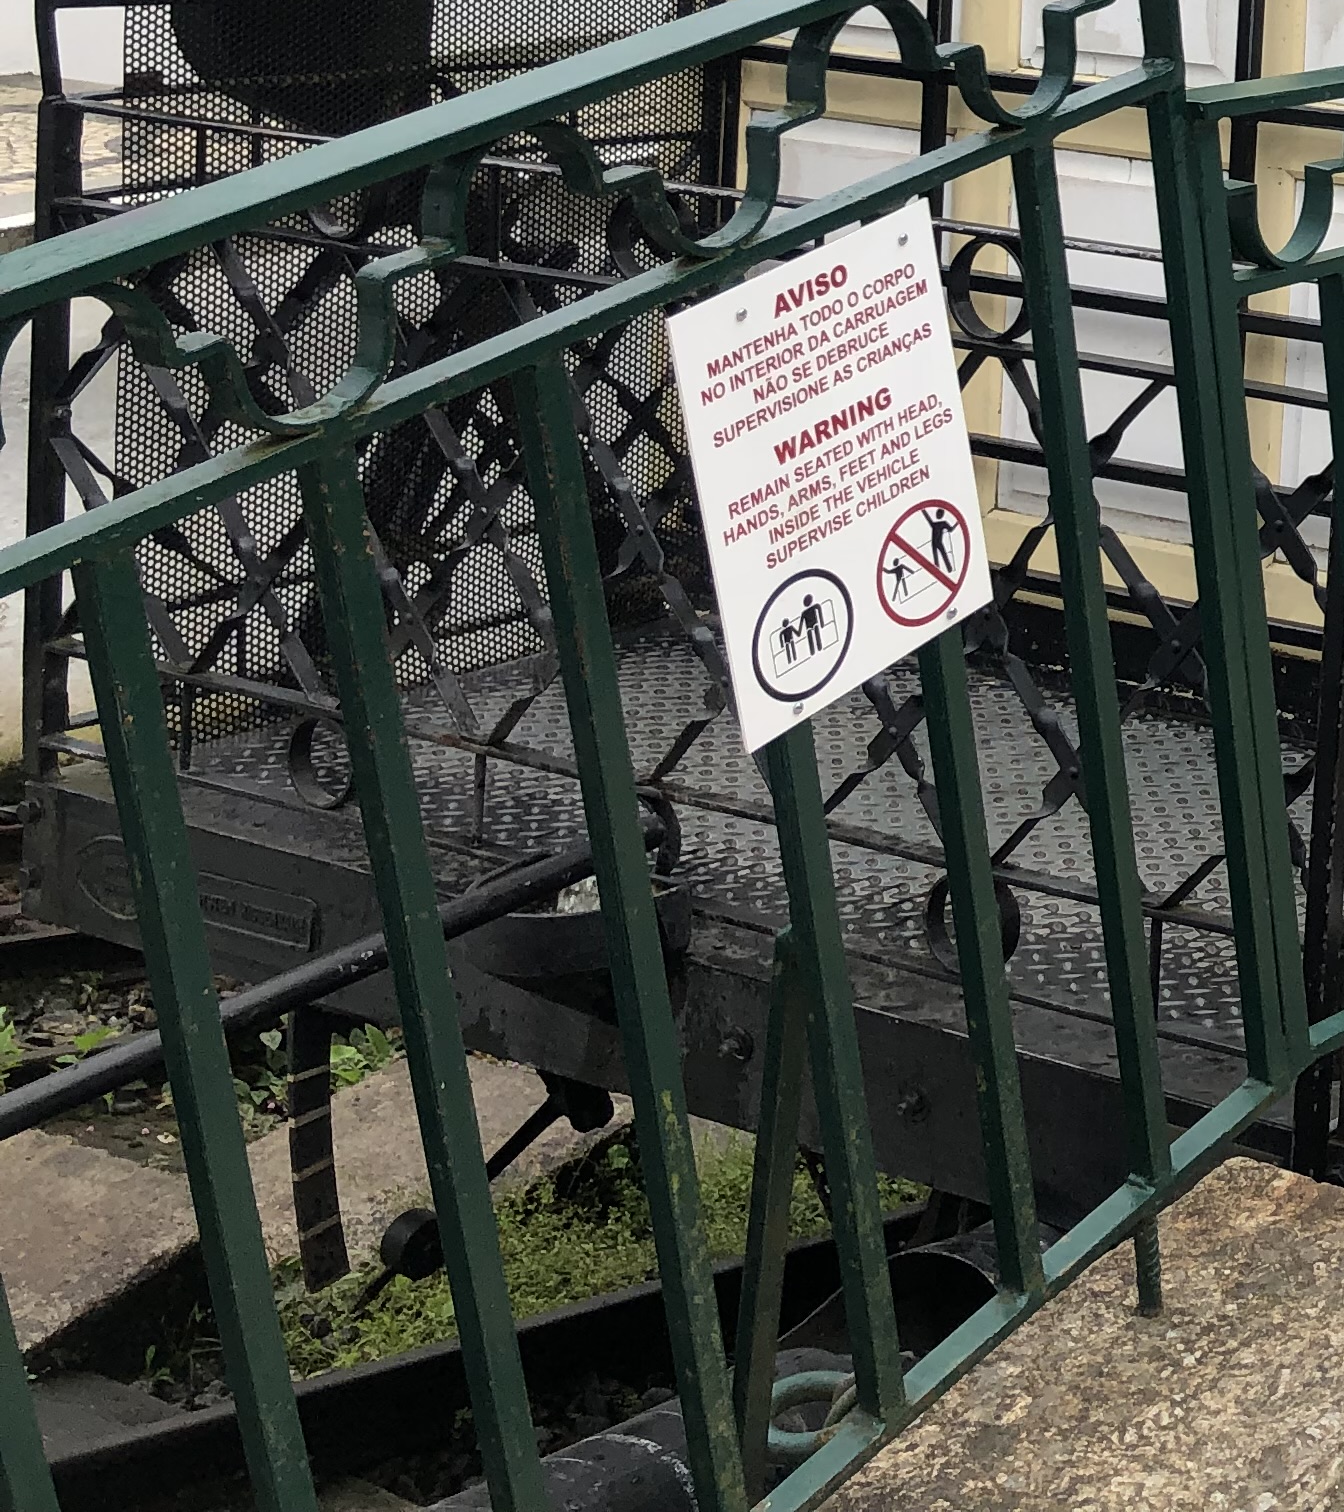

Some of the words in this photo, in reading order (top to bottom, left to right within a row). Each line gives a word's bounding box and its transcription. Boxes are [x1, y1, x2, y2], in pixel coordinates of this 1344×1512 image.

[700, 382, 726, 406] NO
[729, 342, 805, 391] INTERIOR
[808, 330, 831, 352] DA
[833, 279, 928, 338] CARRUAGEM
[707, 323, 798, 378] MANTENHA
[800, 299, 844, 331] TODO
[847, 291, 859, 308] O
[863, 263, 915, 300] CORPO
[774, 265, 848, 319] AVISO
[713, 377, 830, 449] SUPERVISIONE
[833, 364, 854, 387] AS
[856, 322, 933, 373] CRIANÇAS
[753, 375, 789, 404] NÃO
[792, 361, 813, 384] SE
[816, 322, 890, 371] DEBRUCE
[723, 504, 785, 547] HANDS,
[788, 475, 837, 512] ARMS,
[839, 449, 877, 482] FEET
[880, 433, 911, 461] AND
[914, 408, 953, 441] LEGS
[728, 473, 791, 520] REMAIN
[794, 440, 854, 483] SEATED
[856, 417, 895, 449] WITH
[897, 393, 943, 427] HEAD,
[773, 387, 893, 466] WARNING
[766, 511, 854, 570] SUPERVISE
[856, 465, 931, 518] CHILDREN
[768, 504, 821, 545] INSIDE
[823, 486, 855, 512] THE
[856, 448, 921, 494] VEHICLE
